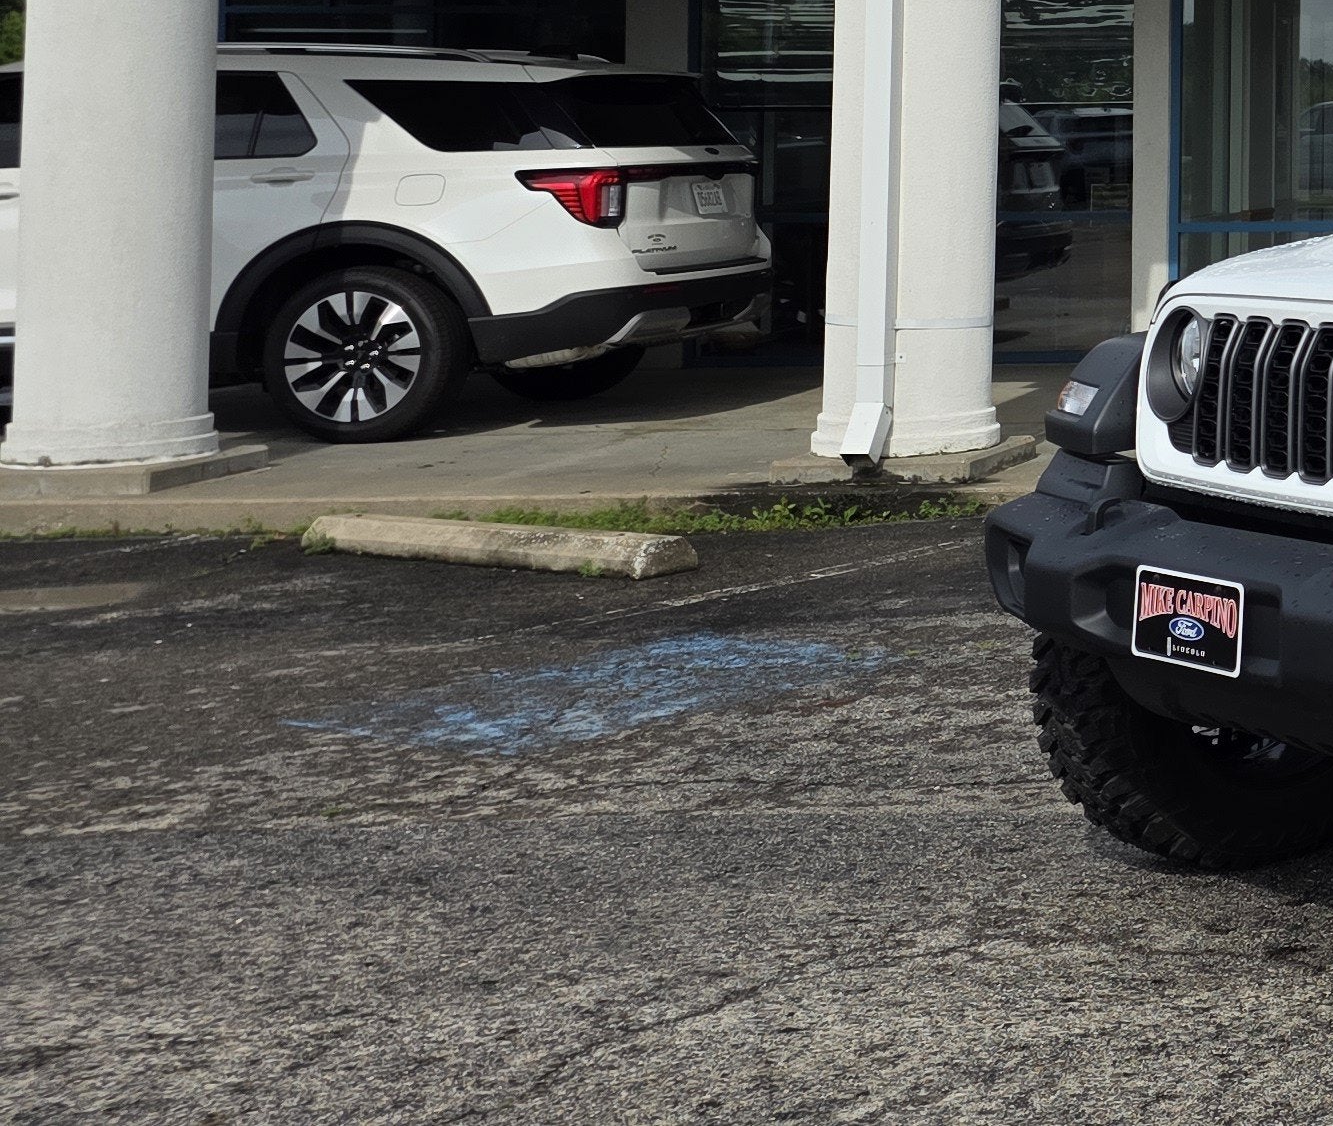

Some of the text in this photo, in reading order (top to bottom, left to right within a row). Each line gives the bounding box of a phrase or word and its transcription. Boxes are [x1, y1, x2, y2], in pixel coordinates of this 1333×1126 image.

[1138, 581, 1238, 639] MIKE CARPINO
[1174, 618, 1198, 638] Ford
